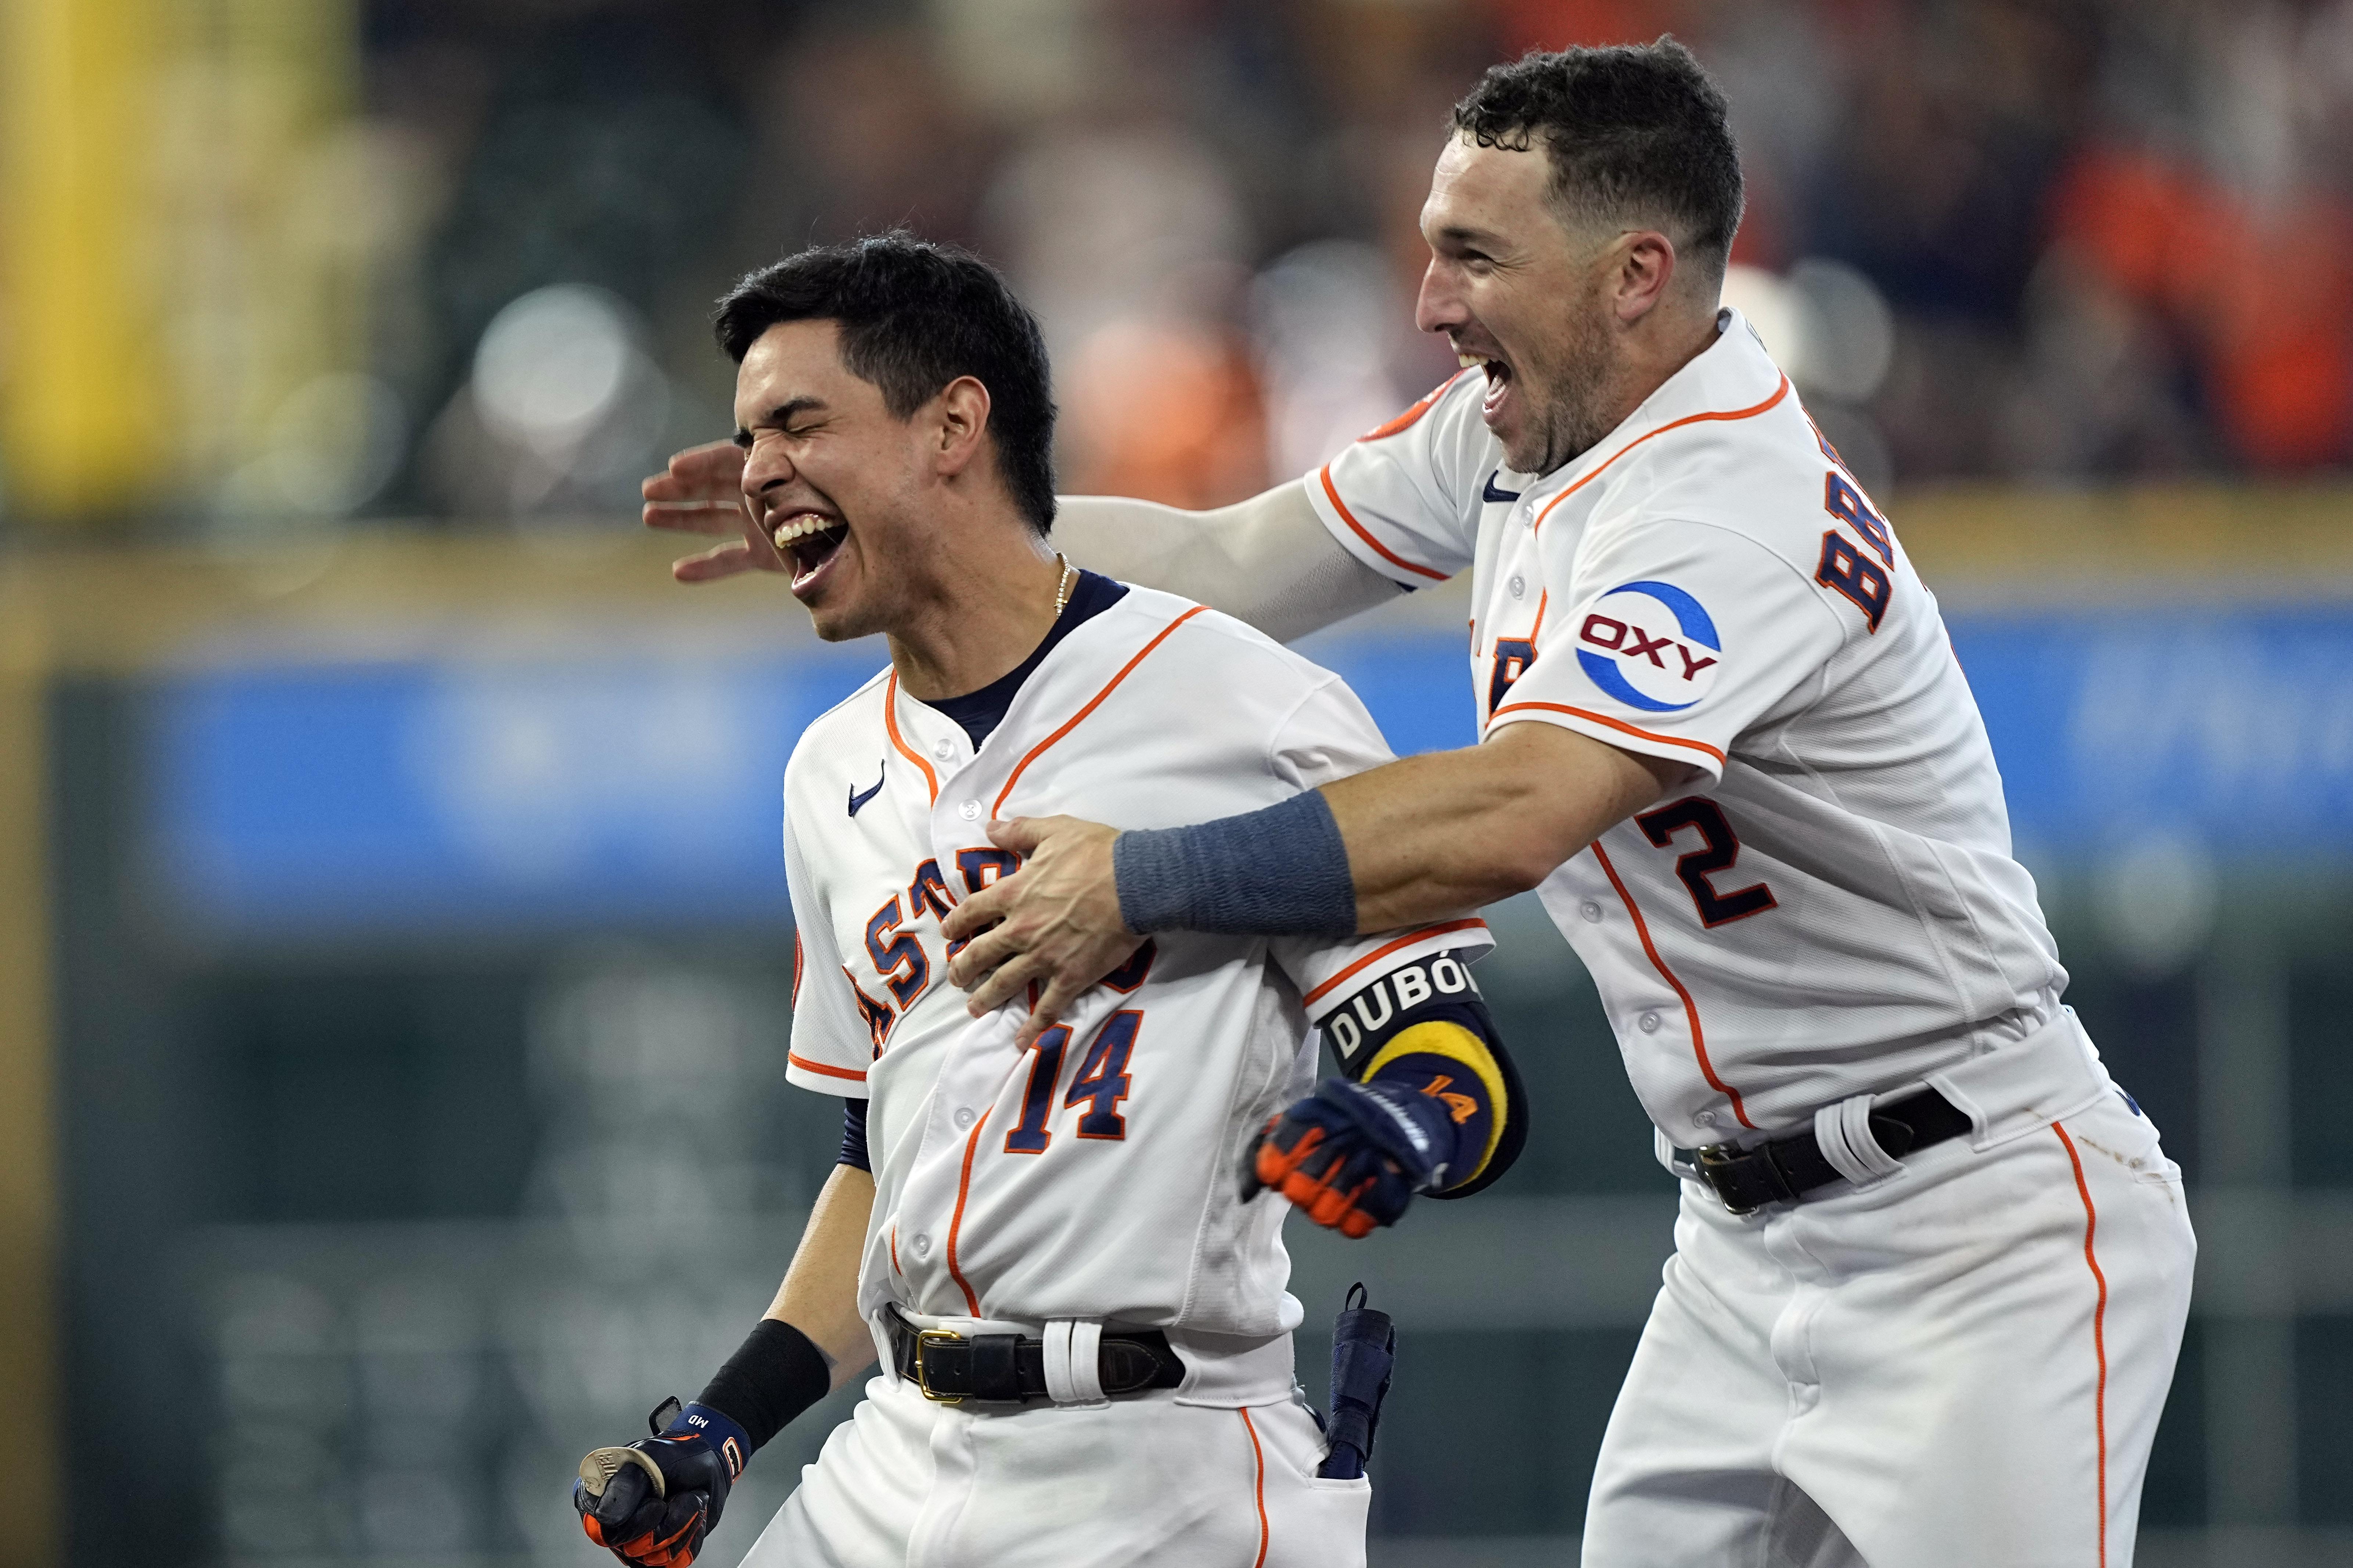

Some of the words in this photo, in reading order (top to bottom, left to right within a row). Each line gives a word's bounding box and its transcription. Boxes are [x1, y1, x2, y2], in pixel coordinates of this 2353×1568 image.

[1580, 614, 1718, 681] OXY
[1634, 796, 1778, 929] 2
[1003, 1010, 1144, 1154] 14
[688, 1415, 709, 1428] MD
